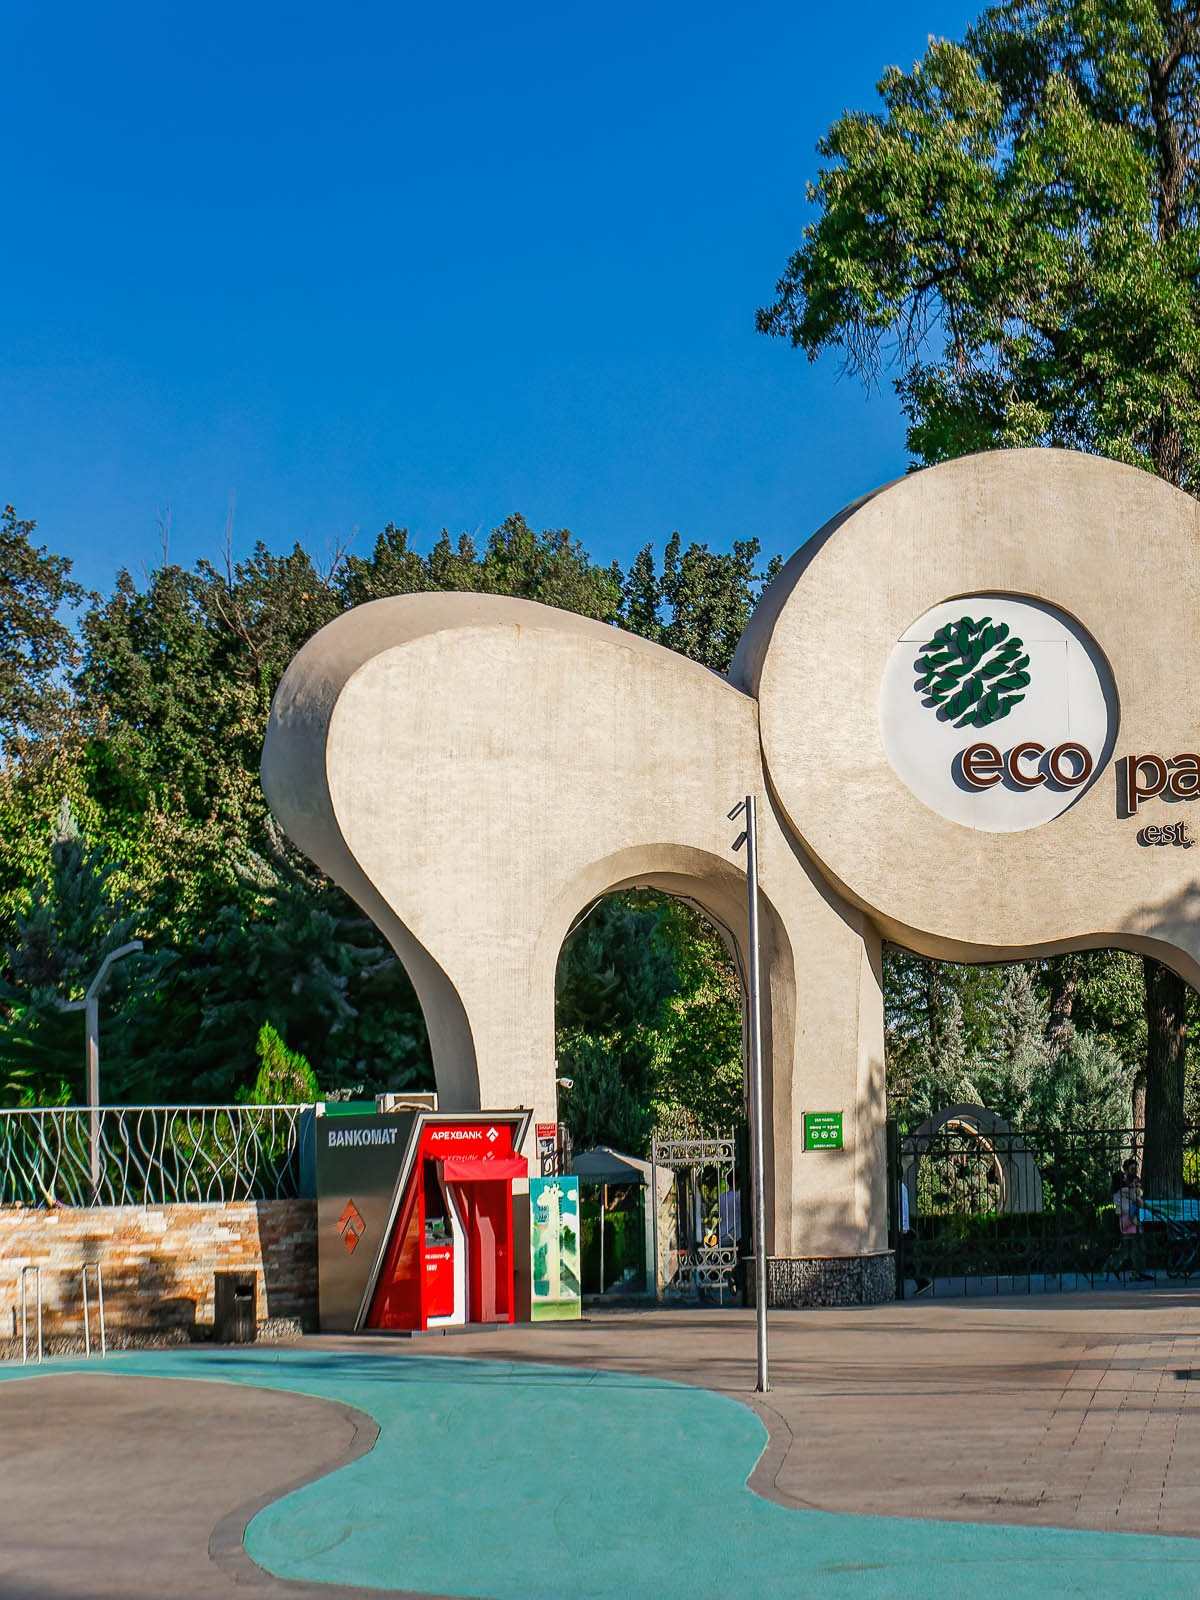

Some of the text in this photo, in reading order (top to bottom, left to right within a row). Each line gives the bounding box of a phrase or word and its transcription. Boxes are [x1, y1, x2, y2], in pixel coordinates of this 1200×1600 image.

[957, 742, 1093, 789] eco
[1141, 820, 1196, 848] est.
[328, 1128, 398, 1147] BANKOMAT
[431, 1130, 483, 1140] APEXBANK
